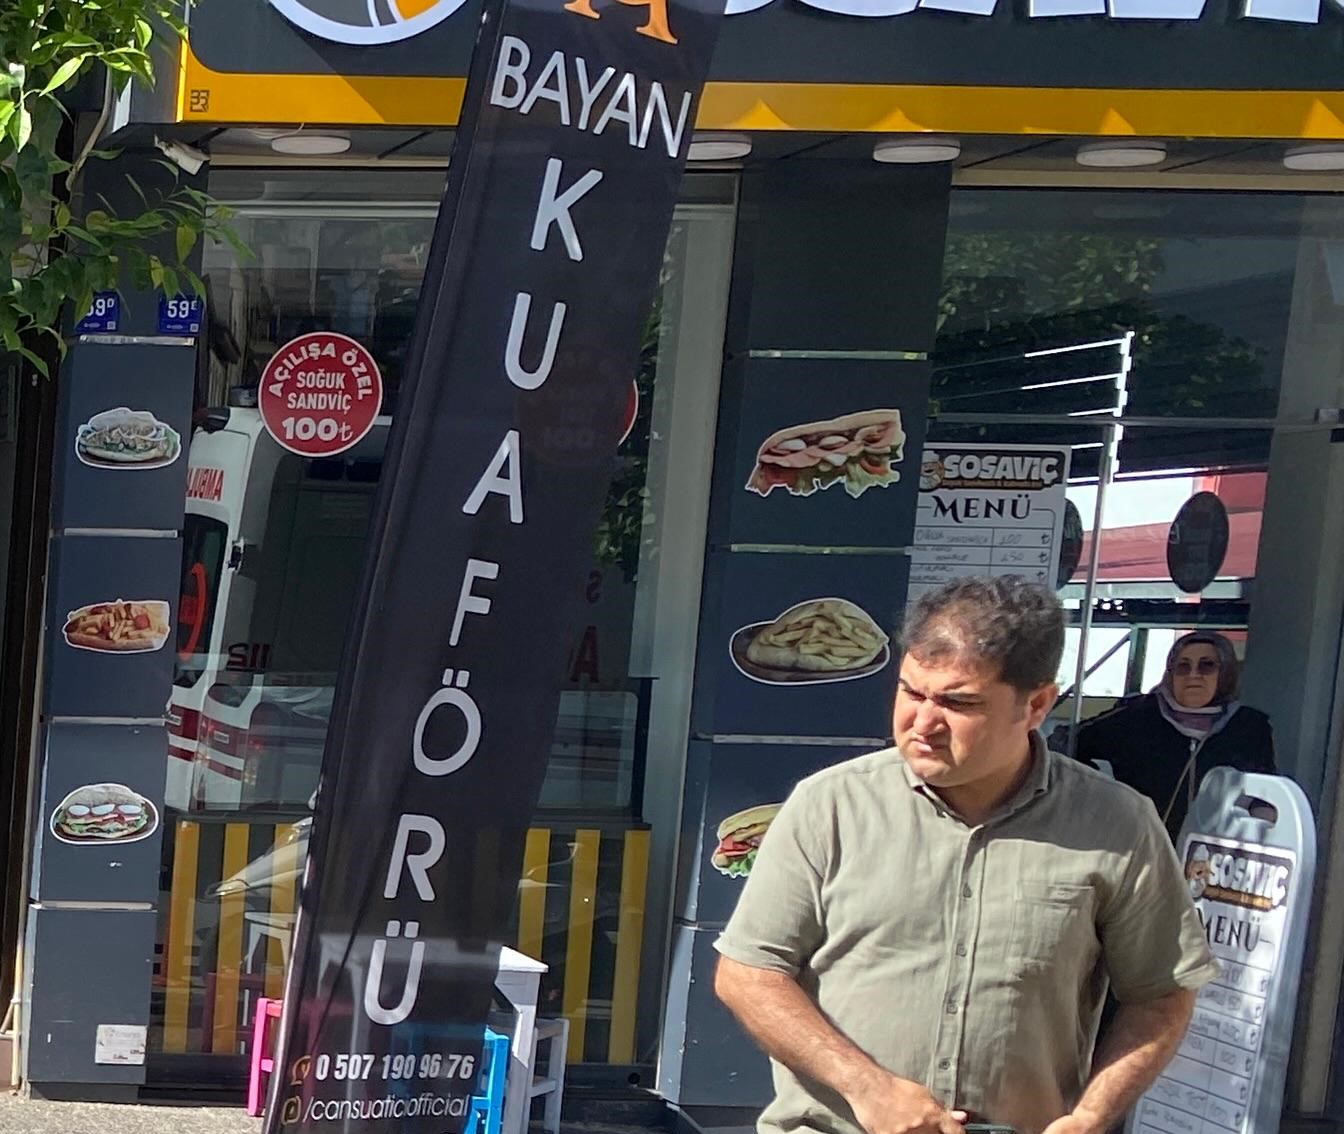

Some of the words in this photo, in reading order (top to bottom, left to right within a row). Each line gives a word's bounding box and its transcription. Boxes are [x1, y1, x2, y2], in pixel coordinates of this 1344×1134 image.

[490, 35, 693, 158] BAYAN
[296, 368, 346, 389] SOĞUK
[287, 390, 352, 415] SANDVİÇ
[931, 494, 1031, 524] MENÜ
[315, 1054, 331, 1080] 0
[334, 1054, 375, 1080] 507
[381, 1054, 416, 1080] 190
[419, 1053, 443, 1079] 96
[448, 1054, 476, 1080] 76
